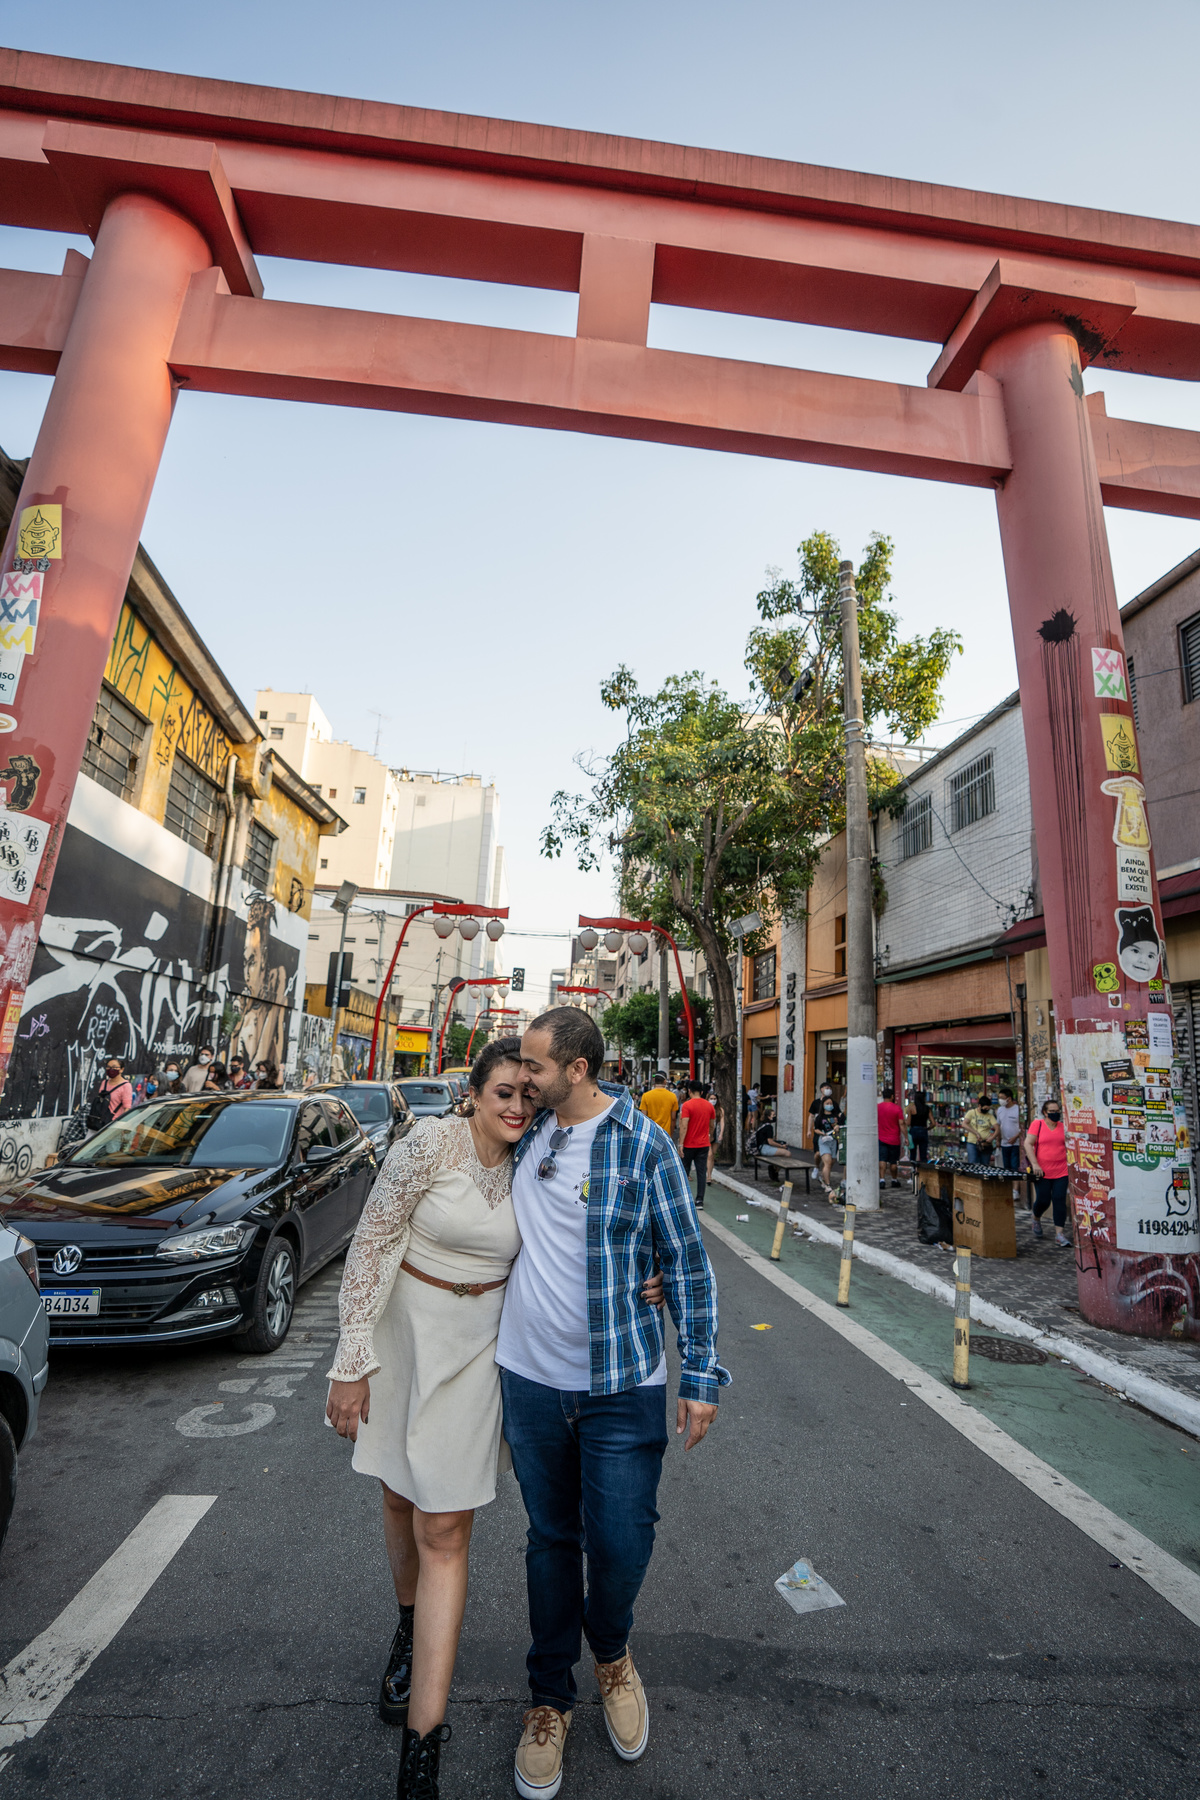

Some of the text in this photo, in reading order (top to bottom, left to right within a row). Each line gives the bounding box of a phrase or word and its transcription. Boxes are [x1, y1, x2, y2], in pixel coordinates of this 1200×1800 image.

[1125, 858, 1146, 867] AINDA
[1121, 866, 1149, 876] BEM QUE
[1128, 875, 1146, 884] VOCÊ
[1125, 883, 1148, 893] EXISTE!
[1149, 1144, 1175, 1153] POR QUE
[965, 1217, 981, 1228] amcor
[41, 1297, 90, 1313] B4D34
